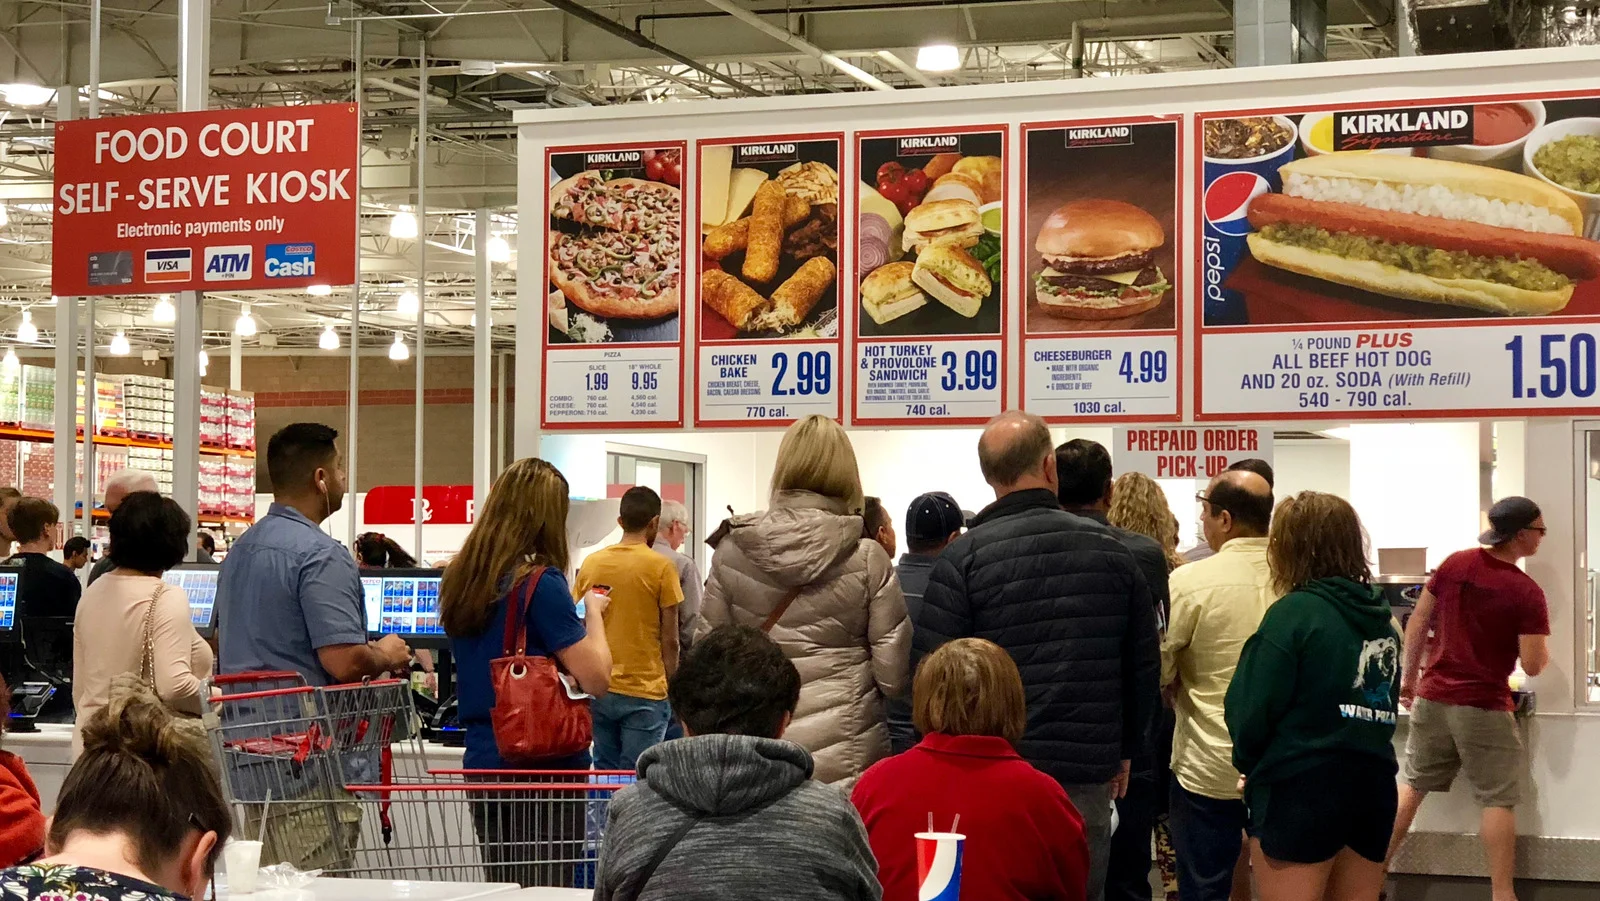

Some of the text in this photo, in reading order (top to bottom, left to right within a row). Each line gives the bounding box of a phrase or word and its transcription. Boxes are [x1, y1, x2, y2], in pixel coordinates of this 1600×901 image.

[1341, 110, 1469, 135] KIRKLAND
[95, 119, 315, 164] FOOD COURT
[900, 136, 958, 148] KIRKLAND
[1069, 127, 1130, 140] KIRKLAND
[1341, 131, 1469, 151] Signature
[587, 152, 640, 163] KIRKLAND
[741, 144, 796, 156] KIRKLAND
[246, 168, 351, 205] KIOSK
[117, 216, 285, 239] Electronic payments only
[156, 261, 179, 271] VISA
[206, 253, 250, 274] ATM
[264, 257, 316, 277] Cash
[1204, 236, 1225, 302] pepsi
[1307, 337, 1351, 349] POUND
[1355, 332, 1413, 348] PLUS
[865, 345, 933, 357] HOT TURKEY
[1034, 350, 1112, 362] CHEESEBURGER
[711, 354, 757, 366] CHICKEN
[860, 357, 937, 369] & PROVOLONE
[1078, 363, 1099, 371] ORGANIC
[1118, 350, 1167, 383] 4.99
[1272, 350, 1432, 370] ALL BEEF HOT DOG
[1505, 333, 1598, 399] 1.50
[720, 367, 748, 378] BAKE
[771, 351, 831, 395] 2.99
[869, 369, 927, 381] SANDWICH
[941, 350, 997, 391] 3.99
[1051, 373, 1082, 381] INGREDIENTS
[585, 372, 609, 391] 1.99
[632, 371, 658, 390] 9.95
[1240, 371, 1471, 389] AND 20 oz. SODA (With Refill)
[1299, 392, 1329, 407] 540
[1347, 391, 1376, 406] 790
[1383, 390, 1412, 406] cal.
[746, 406, 789, 417] 770 cal.
[906, 404, 951, 416] 740 cal.
[1073, 401, 1126, 414] 1030 cal.
[1127, 429, 1258, 452] PREPAID ORDER
[1157, 455, 1228, 478] PICK-UP
